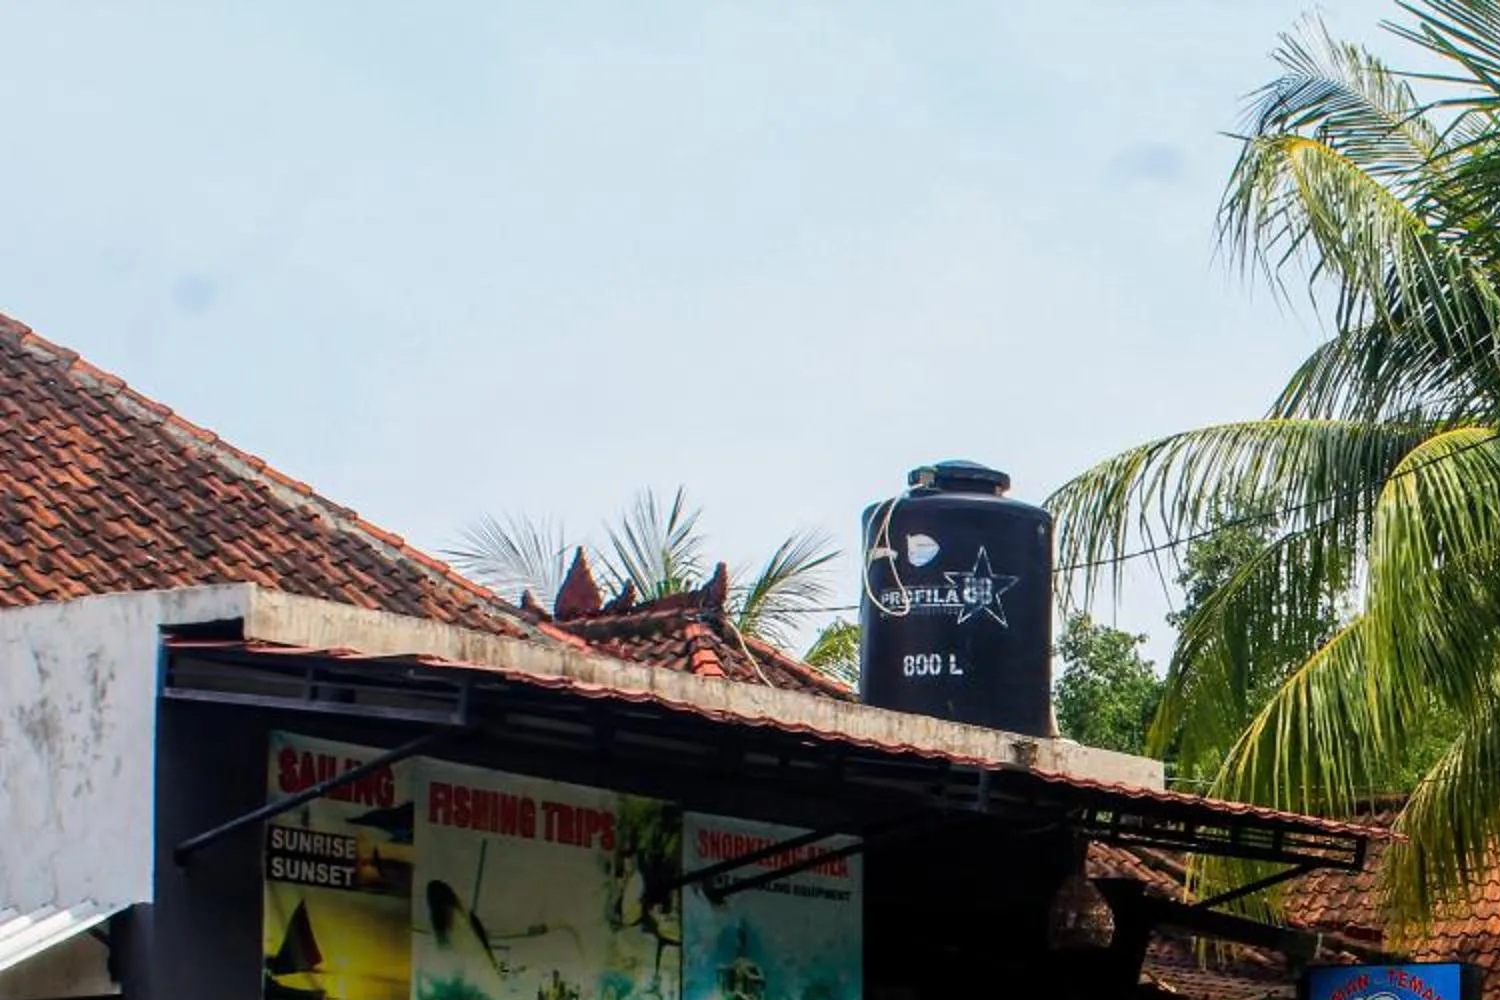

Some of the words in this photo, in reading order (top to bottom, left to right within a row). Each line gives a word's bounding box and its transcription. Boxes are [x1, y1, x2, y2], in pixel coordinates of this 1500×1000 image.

[903, 653, 942, 677] 800
[949, 653, 964, 676] L
[278, 745, 395, 808] SAILING
[428, 781, 536, 839] FISHING
[541, 800, 617, 852] TRIPS
[270, 827, 357, 860] SUNRISE
[270, 856, 357, 888] SUNSET
